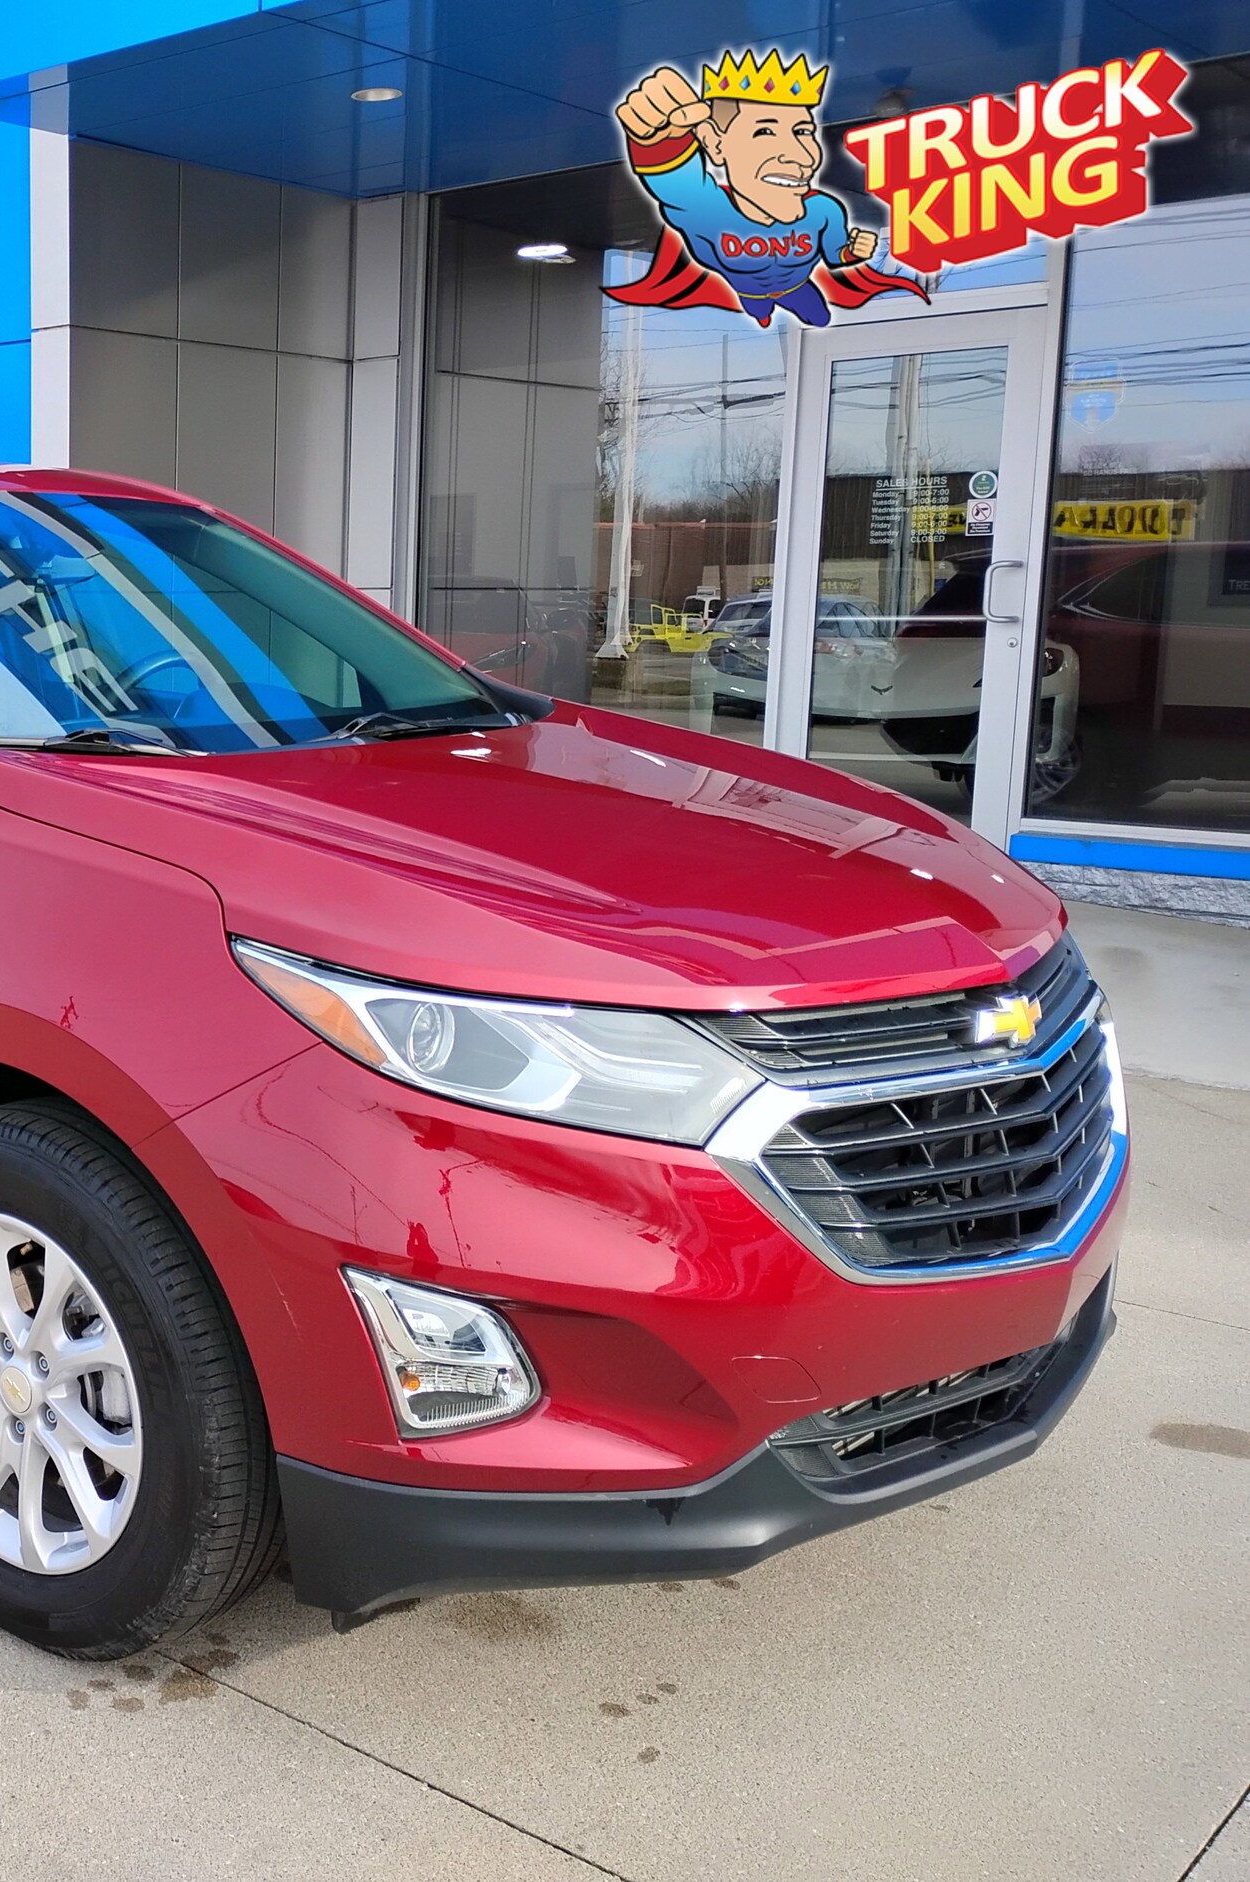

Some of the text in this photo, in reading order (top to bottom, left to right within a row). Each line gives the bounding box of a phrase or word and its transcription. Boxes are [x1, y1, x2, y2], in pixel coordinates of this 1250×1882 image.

[876, 476, 947, 488] SALES HOURS
[871, 514, 902, 522] Thursday
[910, 535, 945, 543] CLOSED
